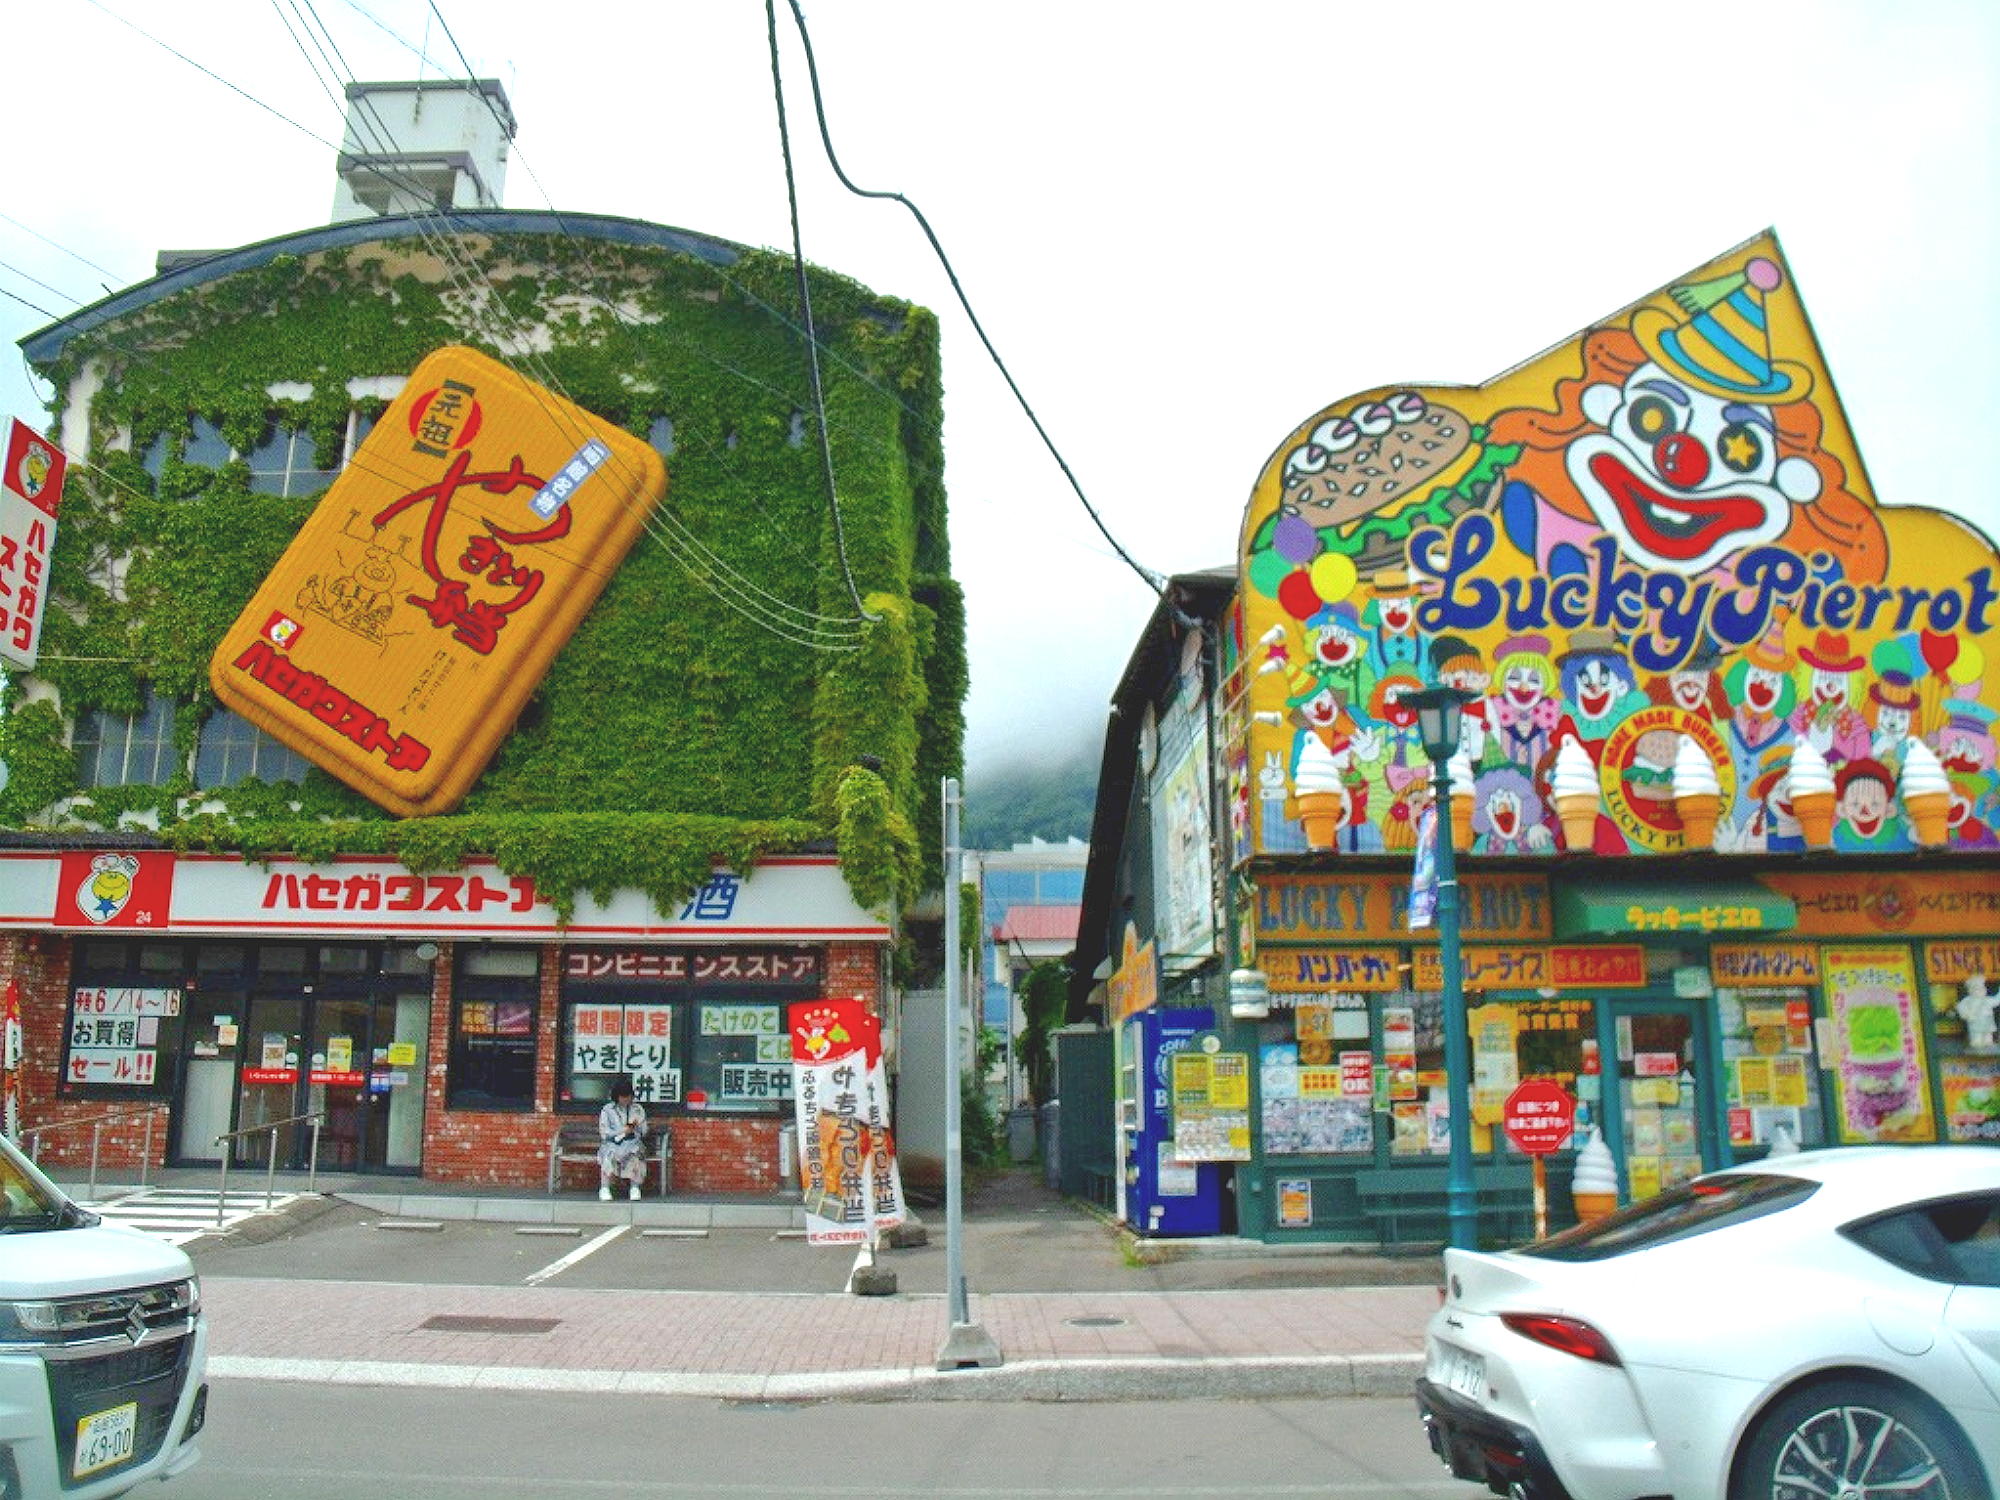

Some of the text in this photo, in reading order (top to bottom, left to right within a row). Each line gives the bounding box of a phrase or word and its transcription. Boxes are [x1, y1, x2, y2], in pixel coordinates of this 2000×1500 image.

[419, 393, 462, 446] 元祖
[13, 519, 46, 651] ハセガワ
[1409, 514, 1998, 673] Lucky Pierrot
[231, 640, 433, 773] ハセガワストア
[1607, 789, 1658, 843] LUCKY
[680, 872, 743, 921] 酒
[1259, 885, 1545, 931] LUCKY PRROT
[135, 910, 152, 924] 24
[1626, 904, 1763, 932] ラッキーピエロ
[568, 953, 816, 978] コンビニエンスストア
[1462, 952, 1545, 981] レーライス
[73, 1020, 135, 1045] お買得
[578, 1009, 669, 1037] 期間限定
[703, 1009, 775, 1032] たけのこ
[577, 1044, 667, 1070] やきとり
[635, 1073, 677, 1101] 弁当
[723, 1068, 792, 1097] 販売中
